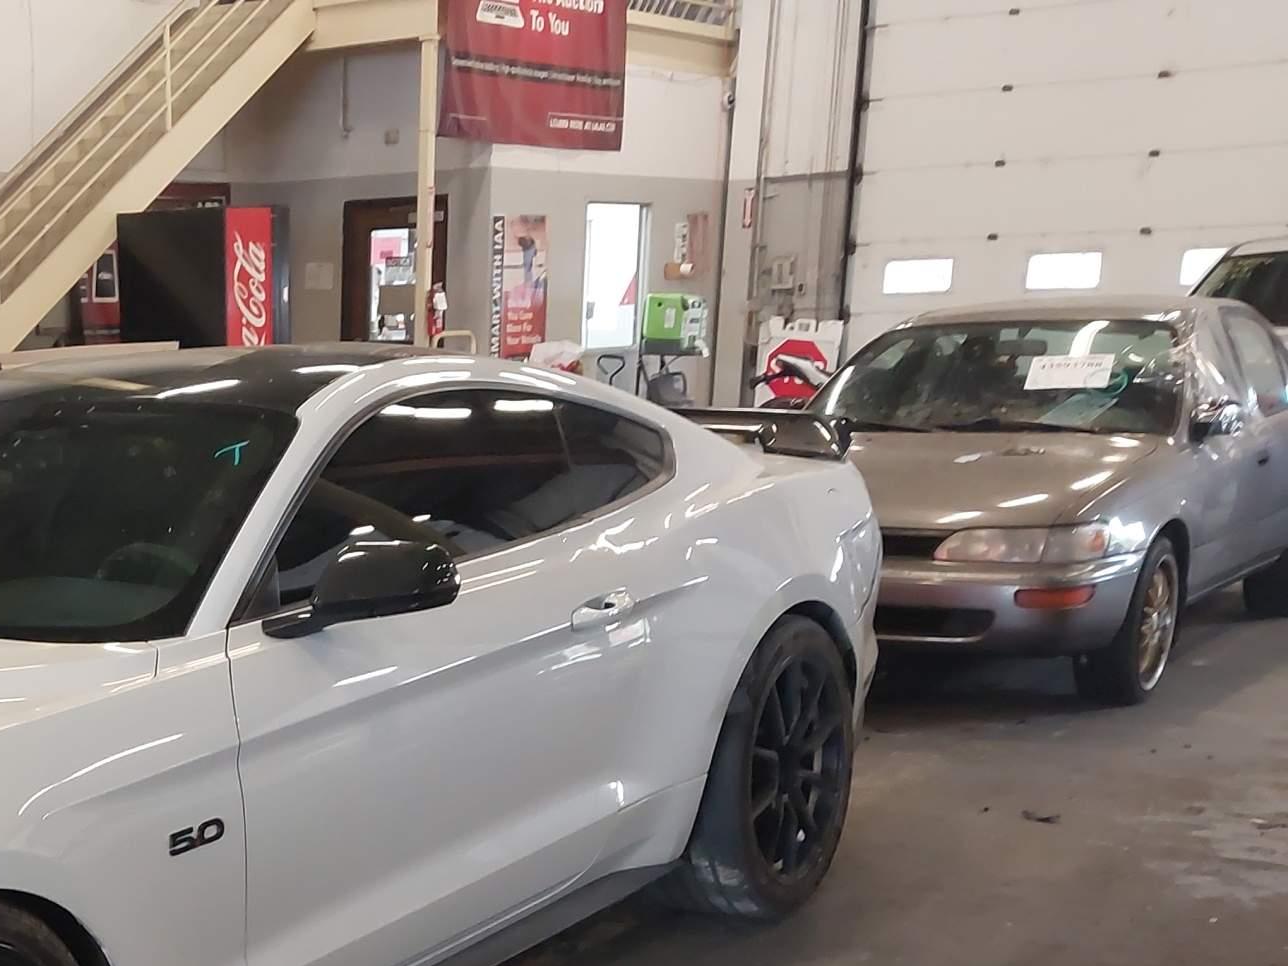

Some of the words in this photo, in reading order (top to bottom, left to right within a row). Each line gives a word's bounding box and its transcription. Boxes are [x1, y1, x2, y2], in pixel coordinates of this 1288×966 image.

[529, 9, 545, 32] To
[548, 12, 570, 36] You
[494, 219, 503, 249] IAA
[234, 231, 266, 346] a-Cola
[492, 254, 502, 300] WITH
